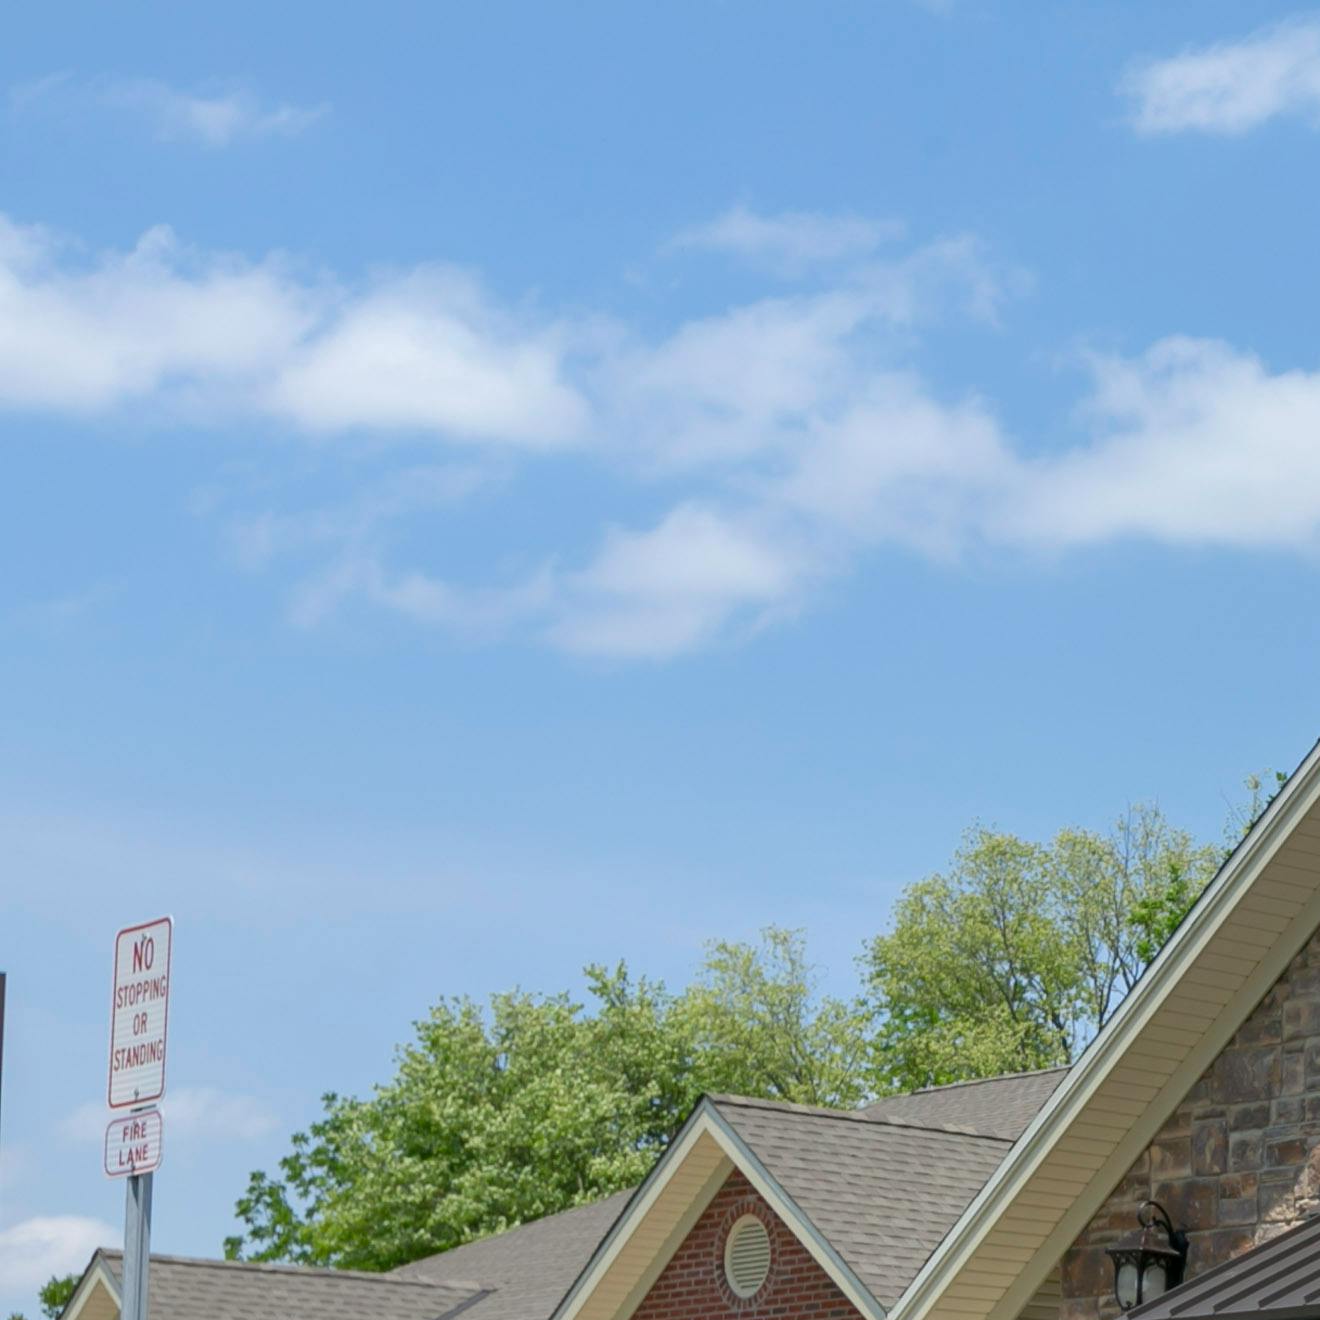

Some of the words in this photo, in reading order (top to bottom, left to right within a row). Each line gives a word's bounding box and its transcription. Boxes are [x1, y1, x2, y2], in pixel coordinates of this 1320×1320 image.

[132, 937, 155, 974] NO
[116, 975, 167, 1009] STOPPING
[133, 1014, 148, 1037] OR
[113, 1040, 164, 1071] STANDING
[122, 1121, 148, 1144] FIRE
[118, 1144, 149, 1167] LANE
